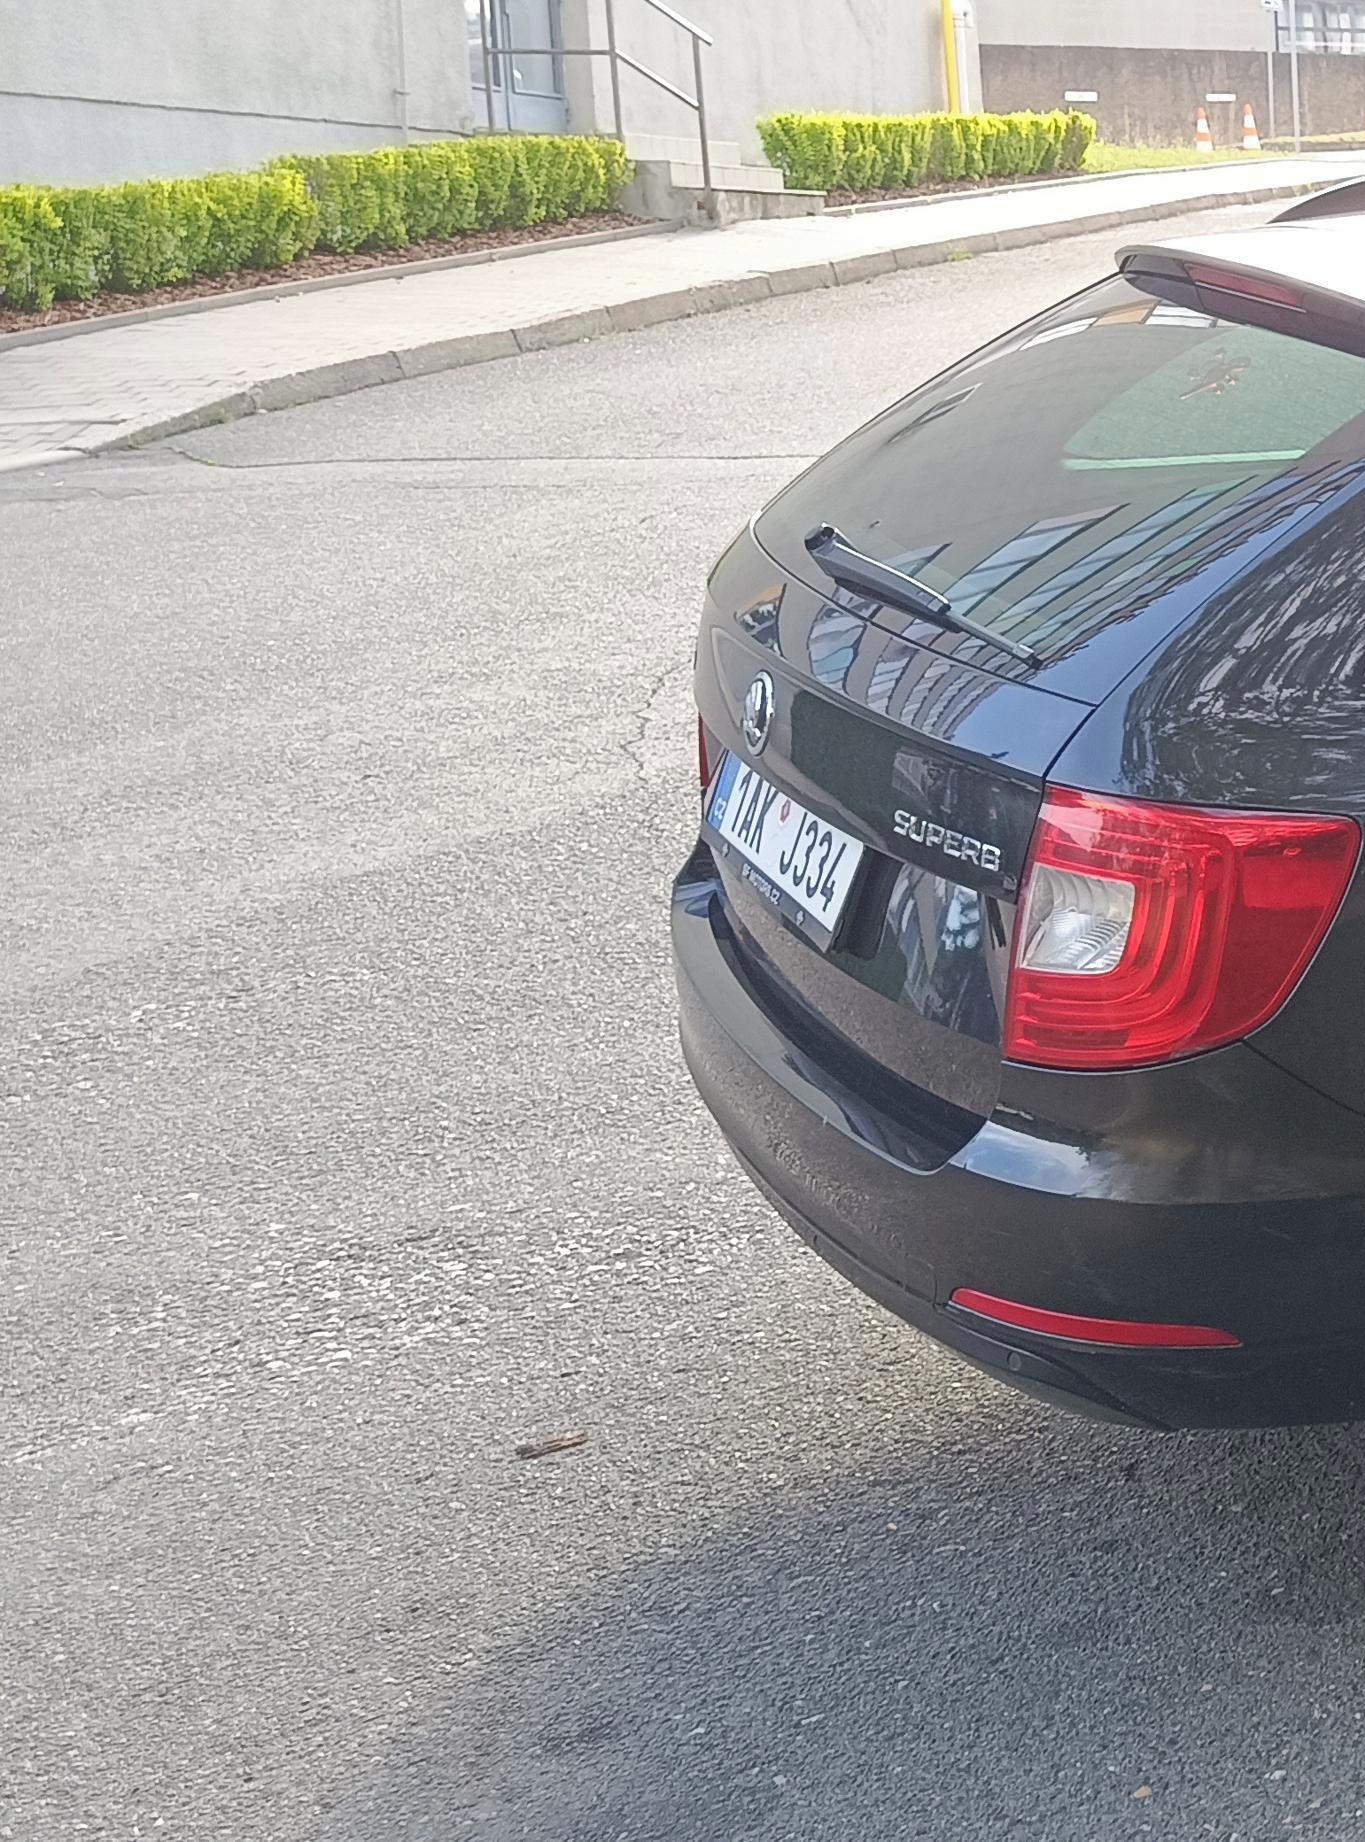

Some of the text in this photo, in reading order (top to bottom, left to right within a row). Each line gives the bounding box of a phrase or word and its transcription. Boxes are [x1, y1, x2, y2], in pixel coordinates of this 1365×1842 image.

[731, 770, 780, 855] 1AK
[779, 811, 848, 912] J334
[893, 809, 1001, 872] SUPERB
